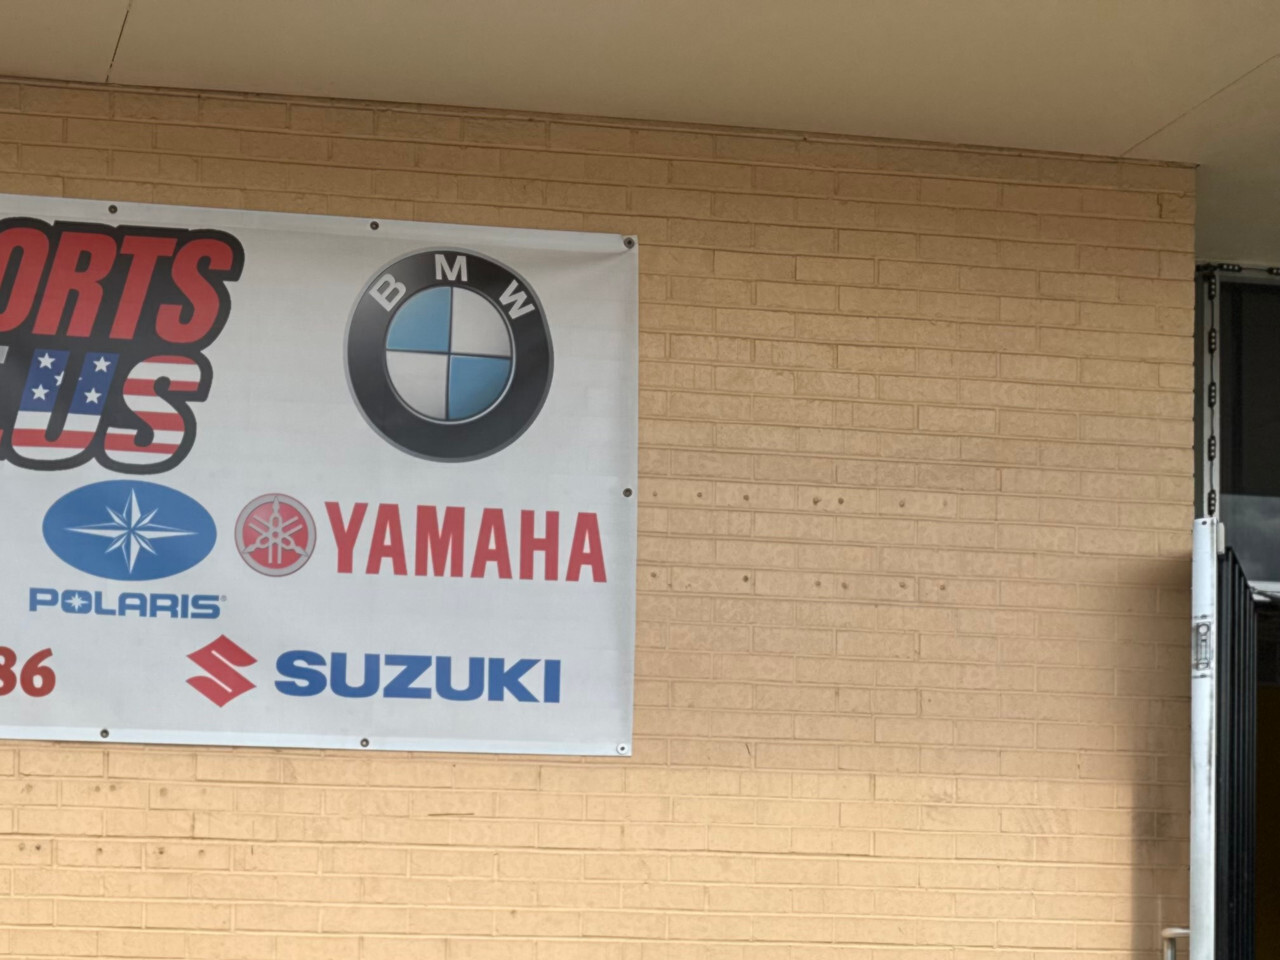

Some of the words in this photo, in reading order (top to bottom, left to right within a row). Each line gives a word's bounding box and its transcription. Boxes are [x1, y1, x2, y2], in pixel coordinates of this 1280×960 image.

[368, 253, 535, 321] BMW
[325, 500, 608, 584] YAMAHA
[29, 586, 222, 619] POLARIS
[274, 649, 562, 704] SUZUKI
